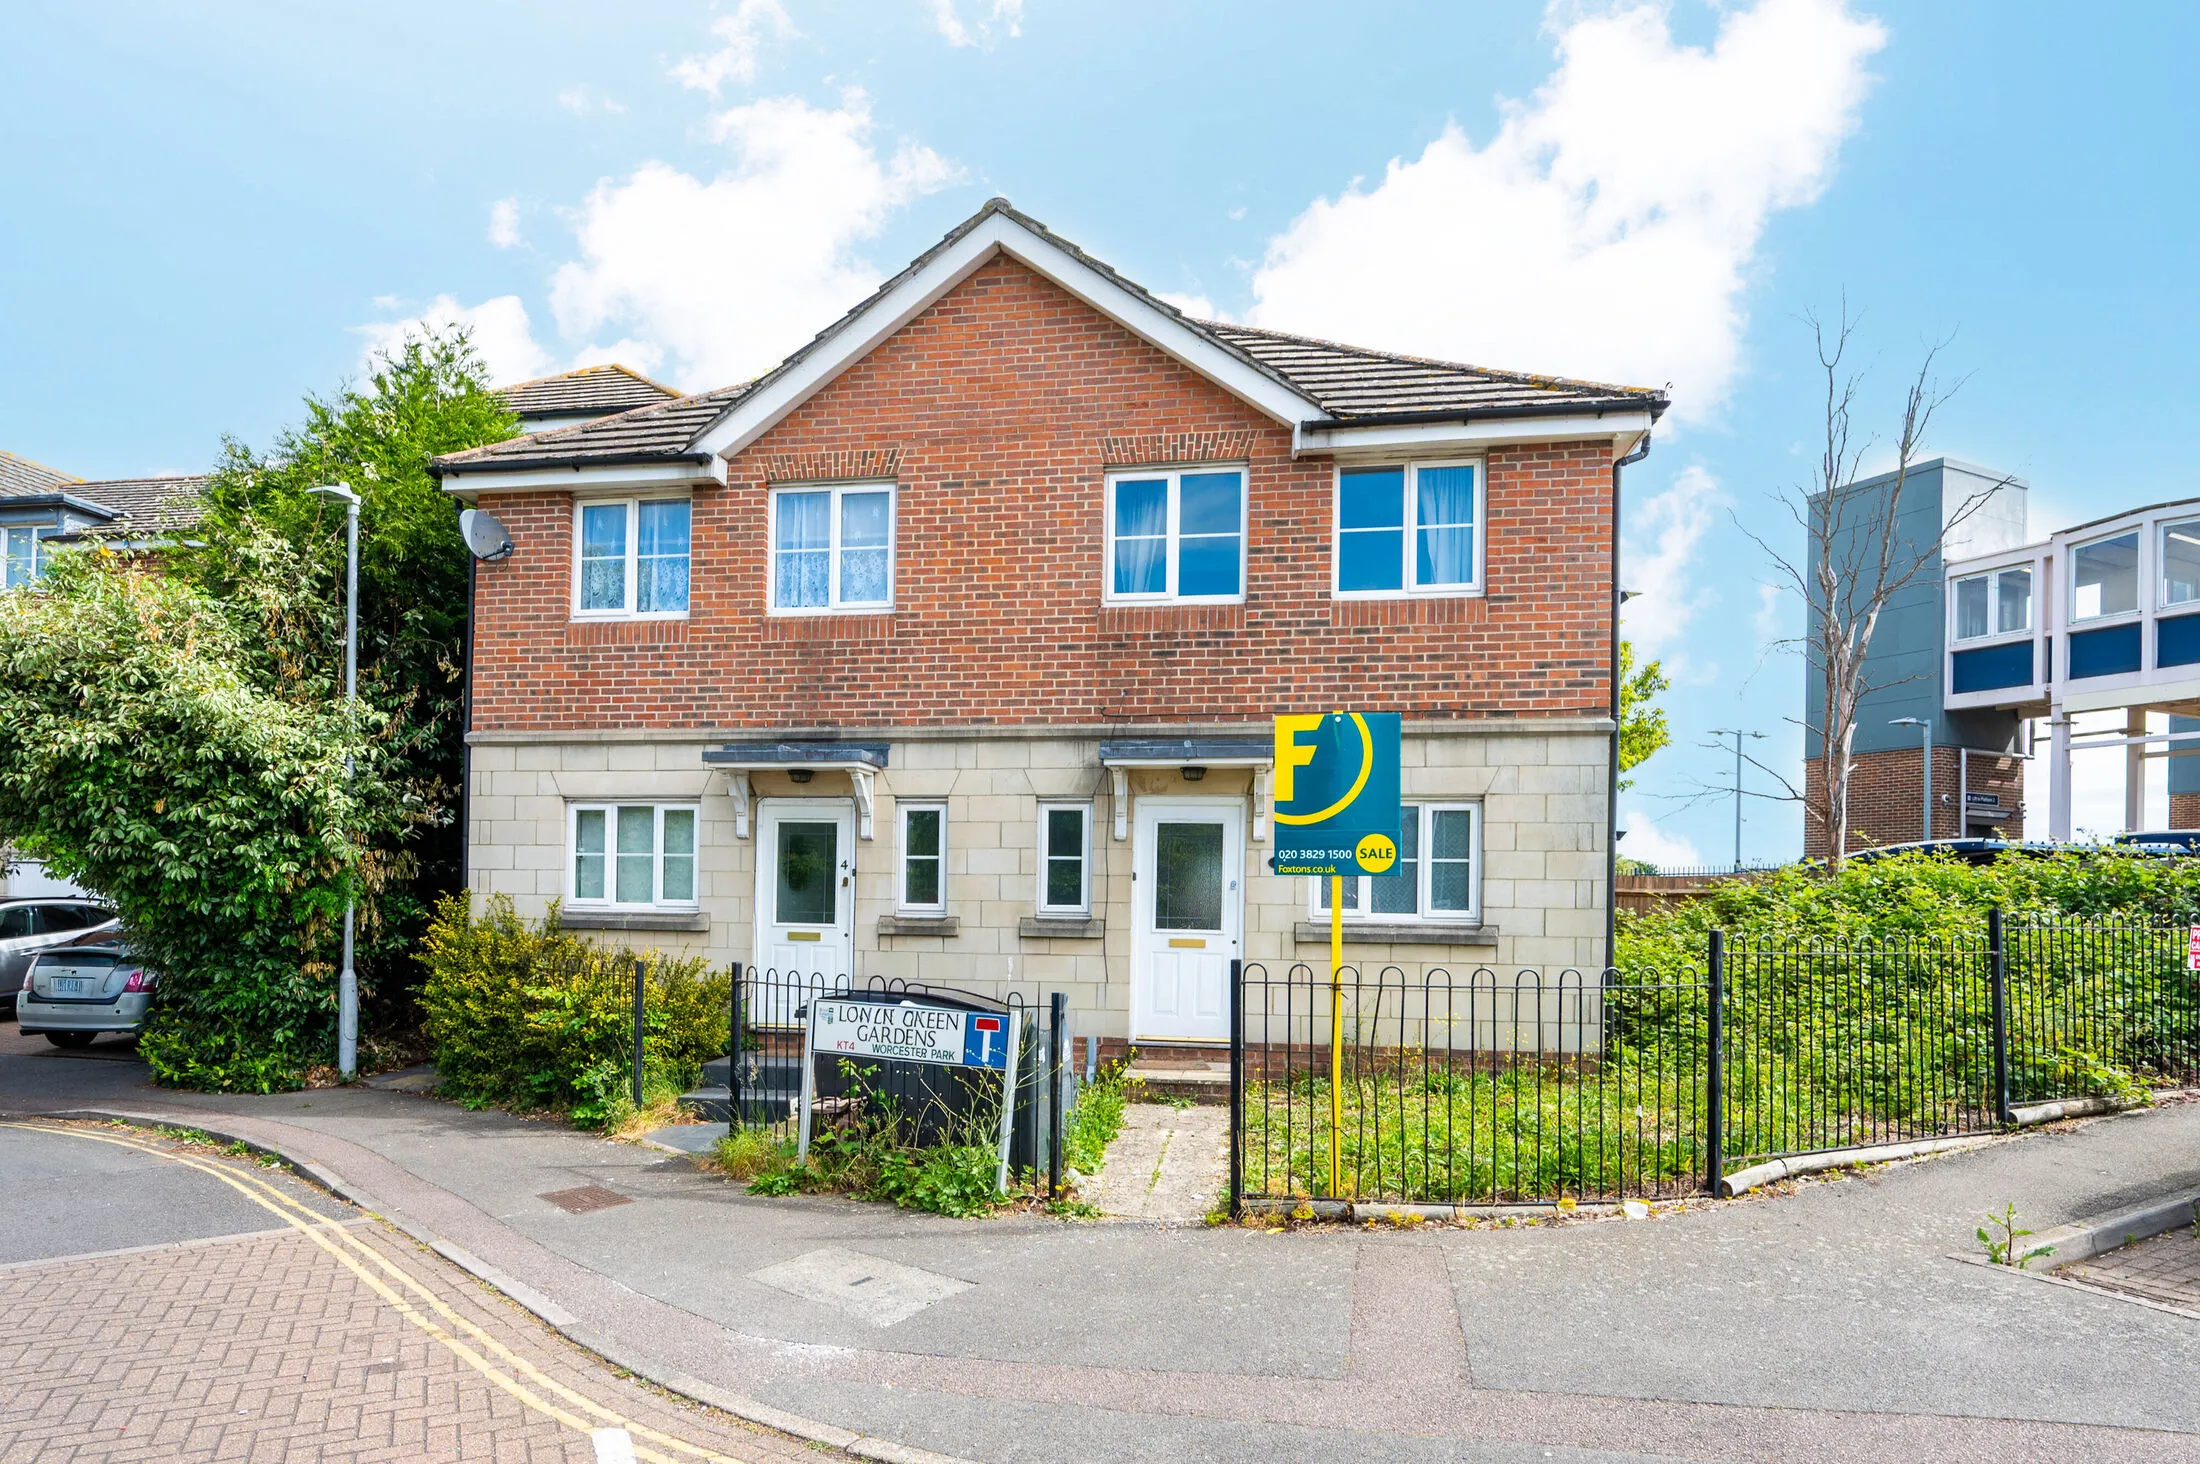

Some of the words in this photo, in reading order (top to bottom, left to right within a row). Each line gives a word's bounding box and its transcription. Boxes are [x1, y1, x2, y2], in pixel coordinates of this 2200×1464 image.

[1278, 849, 1298, 860] 020
[1299, 849, 1326, 860] 3829
[1327, 849, 1353, 860] 1500
[1359, 848, 1393, 859] SALE
[840, 859, 849, 870] 4
[1278, 864, 1336, 873] Foxtons.co.uk
[856, 1025, 937, 1048] GARDENS
[836, 1040, 856, 1051] KT4
[871, 1043, 928, 1059] WORCESTER
[930, 1049, 956, 1061] PARK
